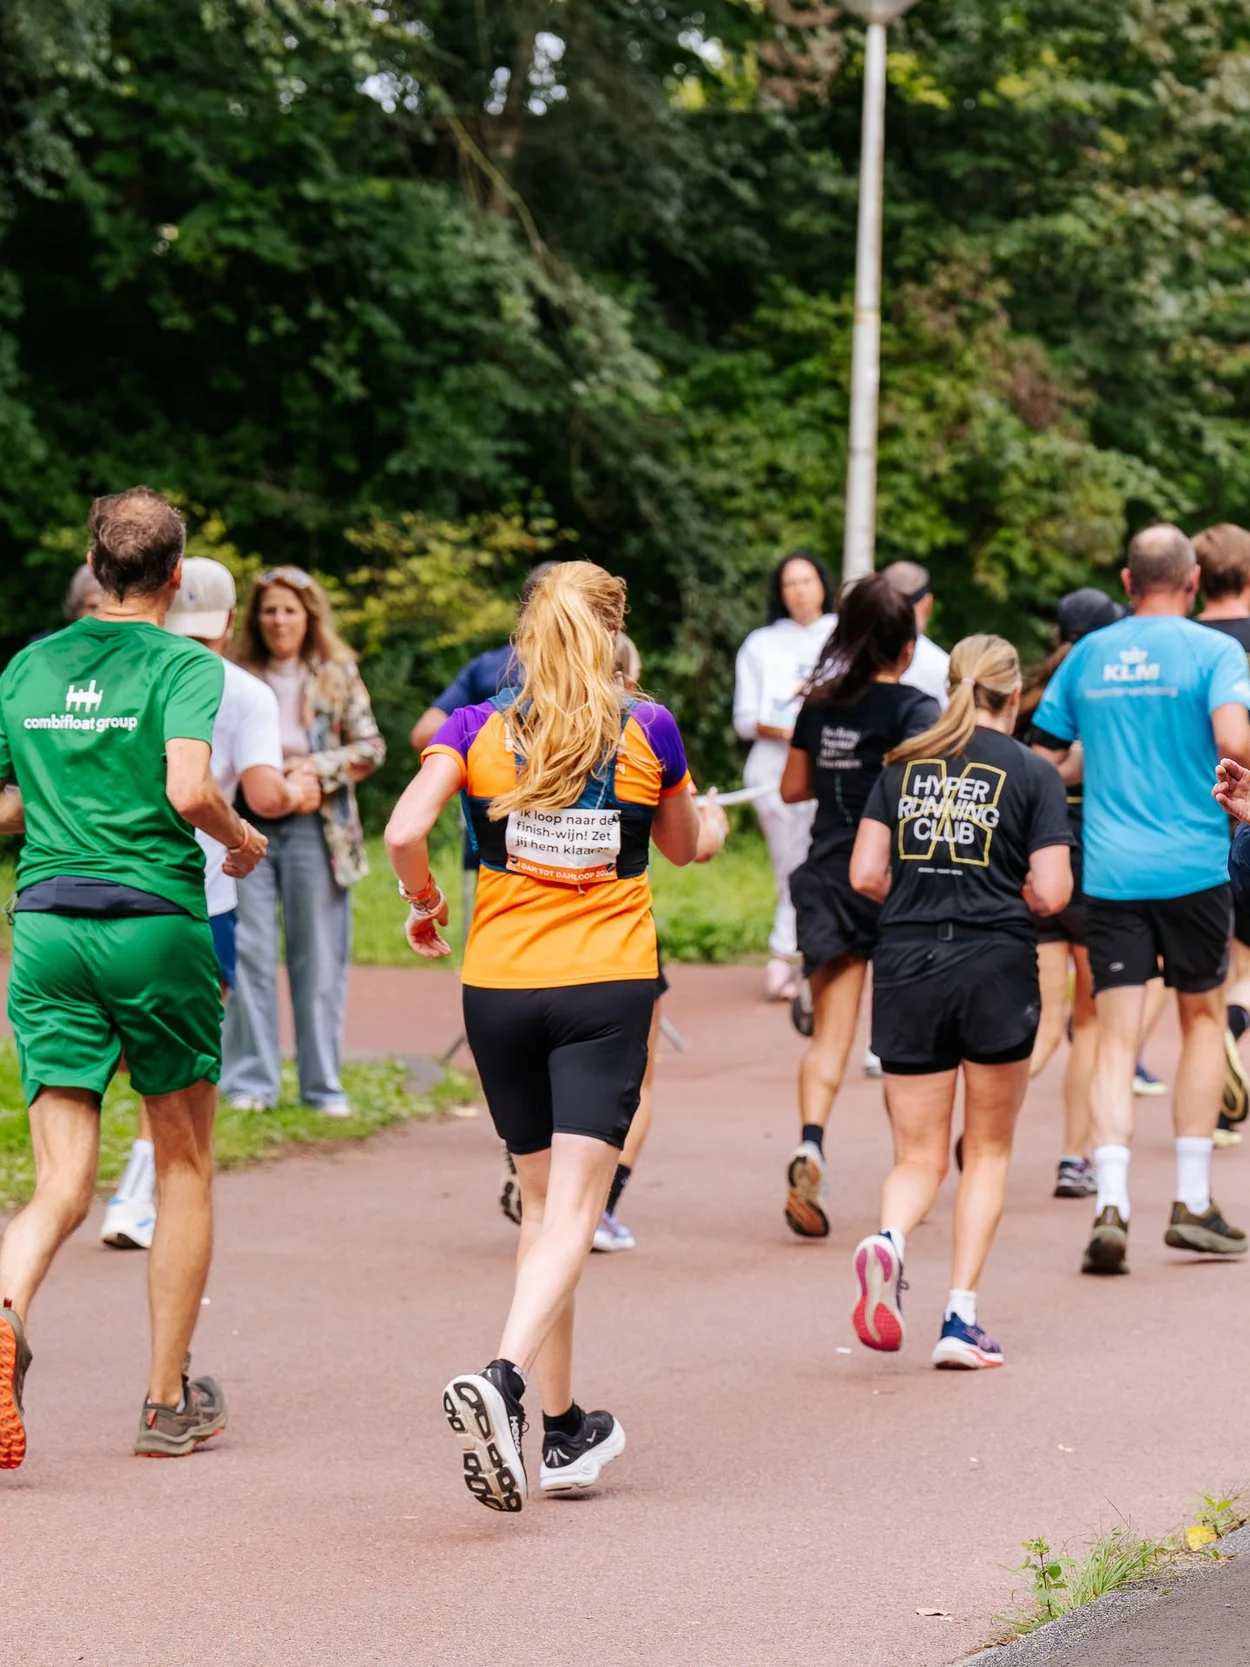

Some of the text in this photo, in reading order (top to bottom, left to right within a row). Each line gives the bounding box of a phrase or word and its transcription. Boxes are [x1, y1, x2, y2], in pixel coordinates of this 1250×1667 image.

[1103, 663, 1160, 681] KLM
[24, 714, 138, 733] combifloat group
[912, 775, 990, 802] HYPER
[534, 811, 562, 825] loop
[566, 816, 596, 825] naar
[599, 815, 614, 826] de
[898, 796, 1000, 829] RUNNING
[516, 821, 612, 842] finish-wijn! Zet
[913, 817, 975, 845] CLUB
[516, 836, 528, 848] jij
[531, 840, 559, 853] hem
[521, 863, 538, 873] DAM
[539, 868, 555, 876] TOT
[556, 871, 595, 880] DAMLOOP
